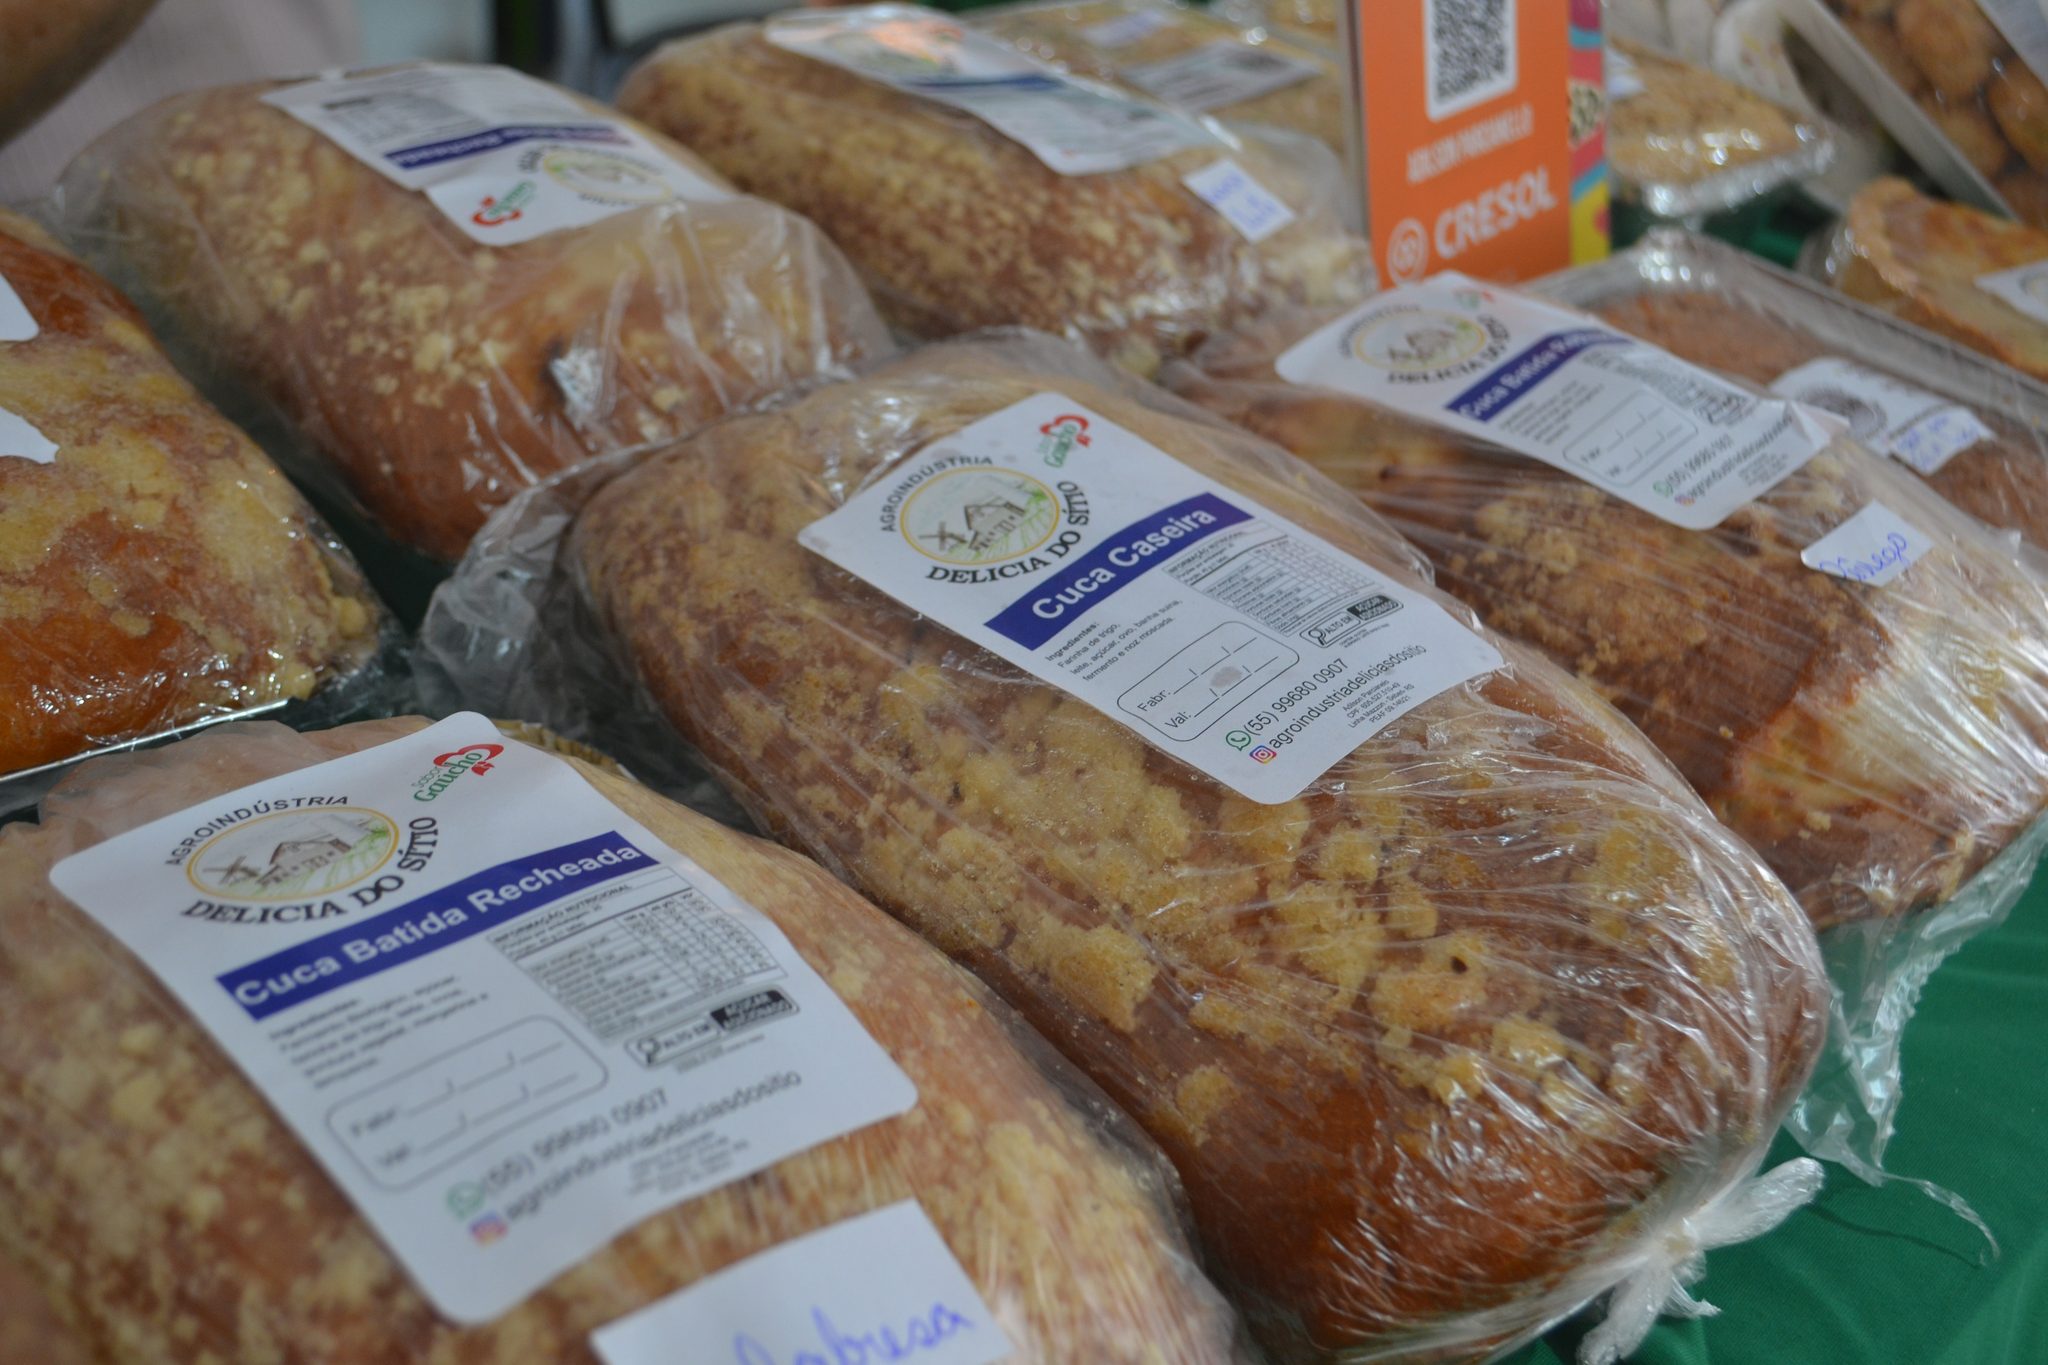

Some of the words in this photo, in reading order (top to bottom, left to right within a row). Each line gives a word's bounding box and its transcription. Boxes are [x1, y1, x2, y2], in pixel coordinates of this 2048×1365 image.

[1434, 164, 1558, 259] CRESOL
[880, 454, 993, 532] AGROINDÚSTRIA
[1056, 480, 1090, 526] SÍTIO
[1032, 567, 1117, 619] Cuca
[1108, 509, 1217, 568] Caseira
[1044, 530, 1082, 558] DO
[925, 556, 1051, 584] DELICIA
[1045, 621, 1100, 662] Ingredientes:
[1057, 645, 1090, 668] Farinha
[1088, 637, 1100, 647] de
[1083, 656, 1119, 682] fermento
[1124, 638, 1140, 652] noz
[1137, 688, 1172, 714] Fabr:
[1244, 709, 1281, 737] (55)
[1271, 679, 1319, 714] 99680
[1317, 657, 1350, 685] 0907
[1164, 709, 1193, 732] Val:
[411, 766, 441, 789] Sabor
[414, 751, 483, 802] Gaúcho
[164, 795, 349, 866] AGROINDÚSTRIA
[180, 899, 348, 924] DELICIA
[351, 874, 405, 908] DO
[398, 816, 439, 872] SÍTIO
[234, 957, 342, 1006] Cuca
[343, 908, 468, 963] Batida
[468, 843, 643, 912] Recheada
